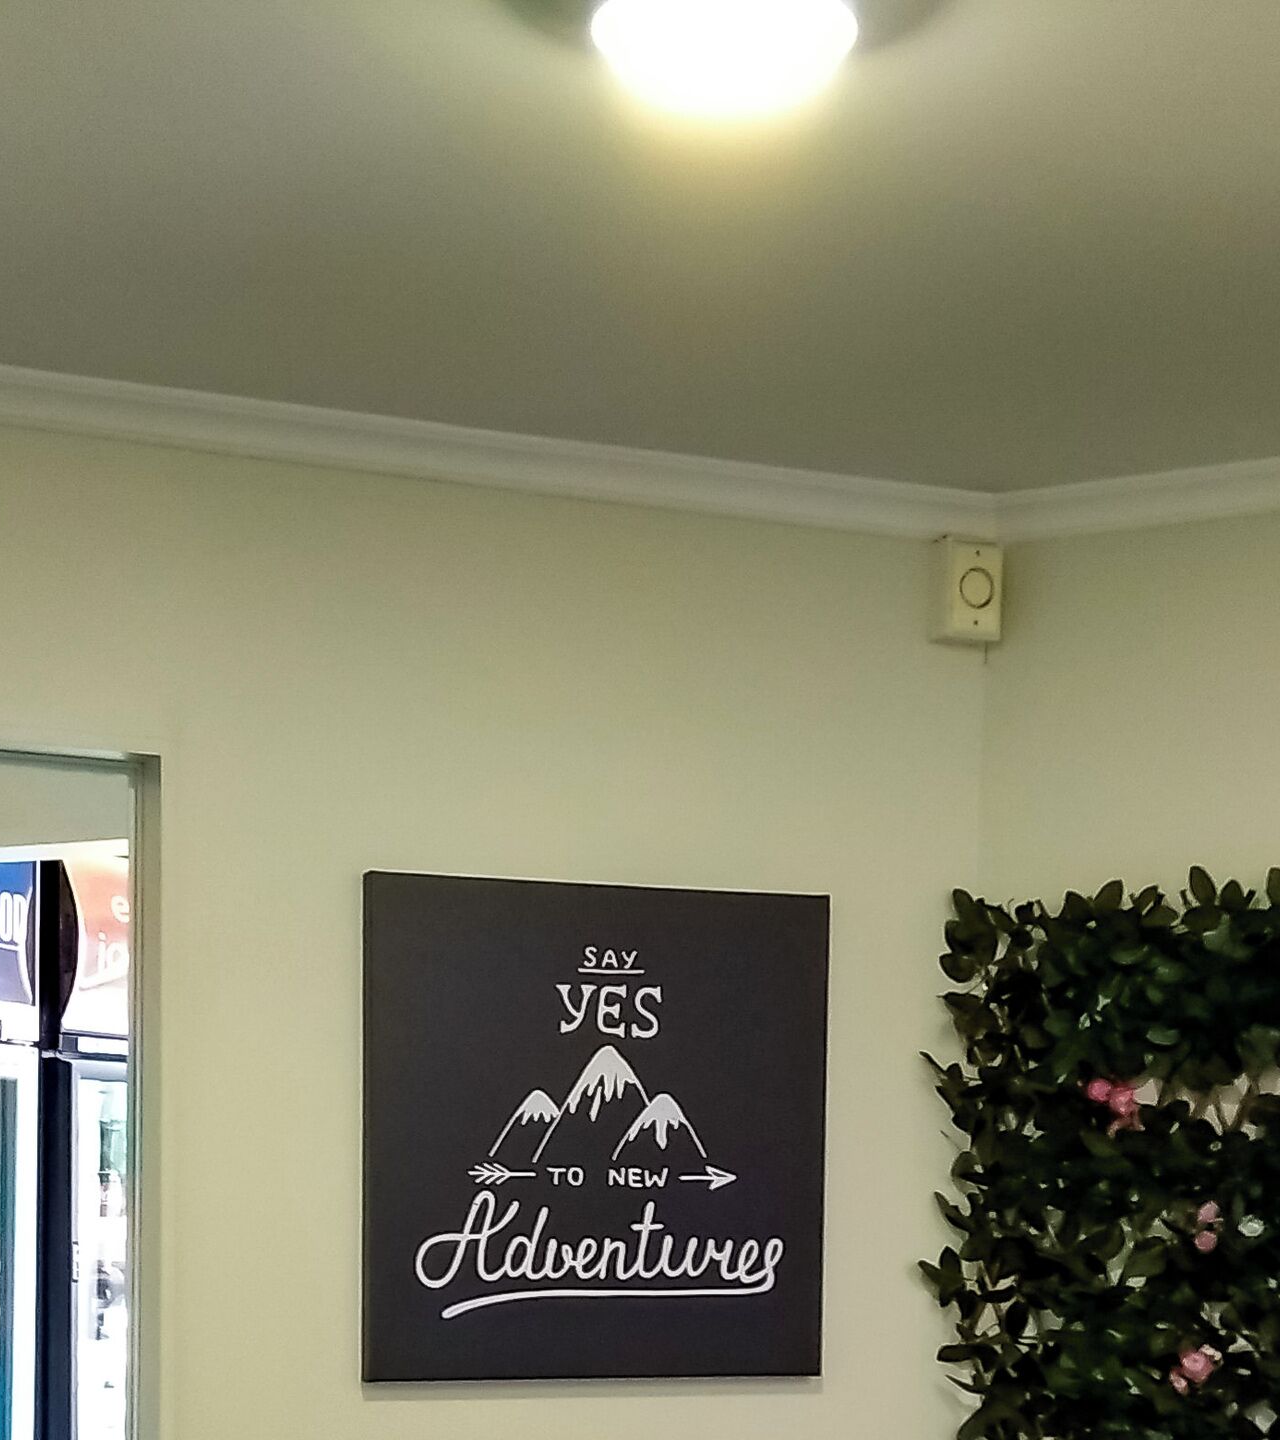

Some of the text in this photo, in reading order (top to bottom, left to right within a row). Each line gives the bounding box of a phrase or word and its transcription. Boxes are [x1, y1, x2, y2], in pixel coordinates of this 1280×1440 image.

[583, 946, 638, 969] SAY
[555, 984, 662, 1038] YES
[546, 1167, 669, 1188] TO NEW
[415, 1190, 783, 1290] Adventures
